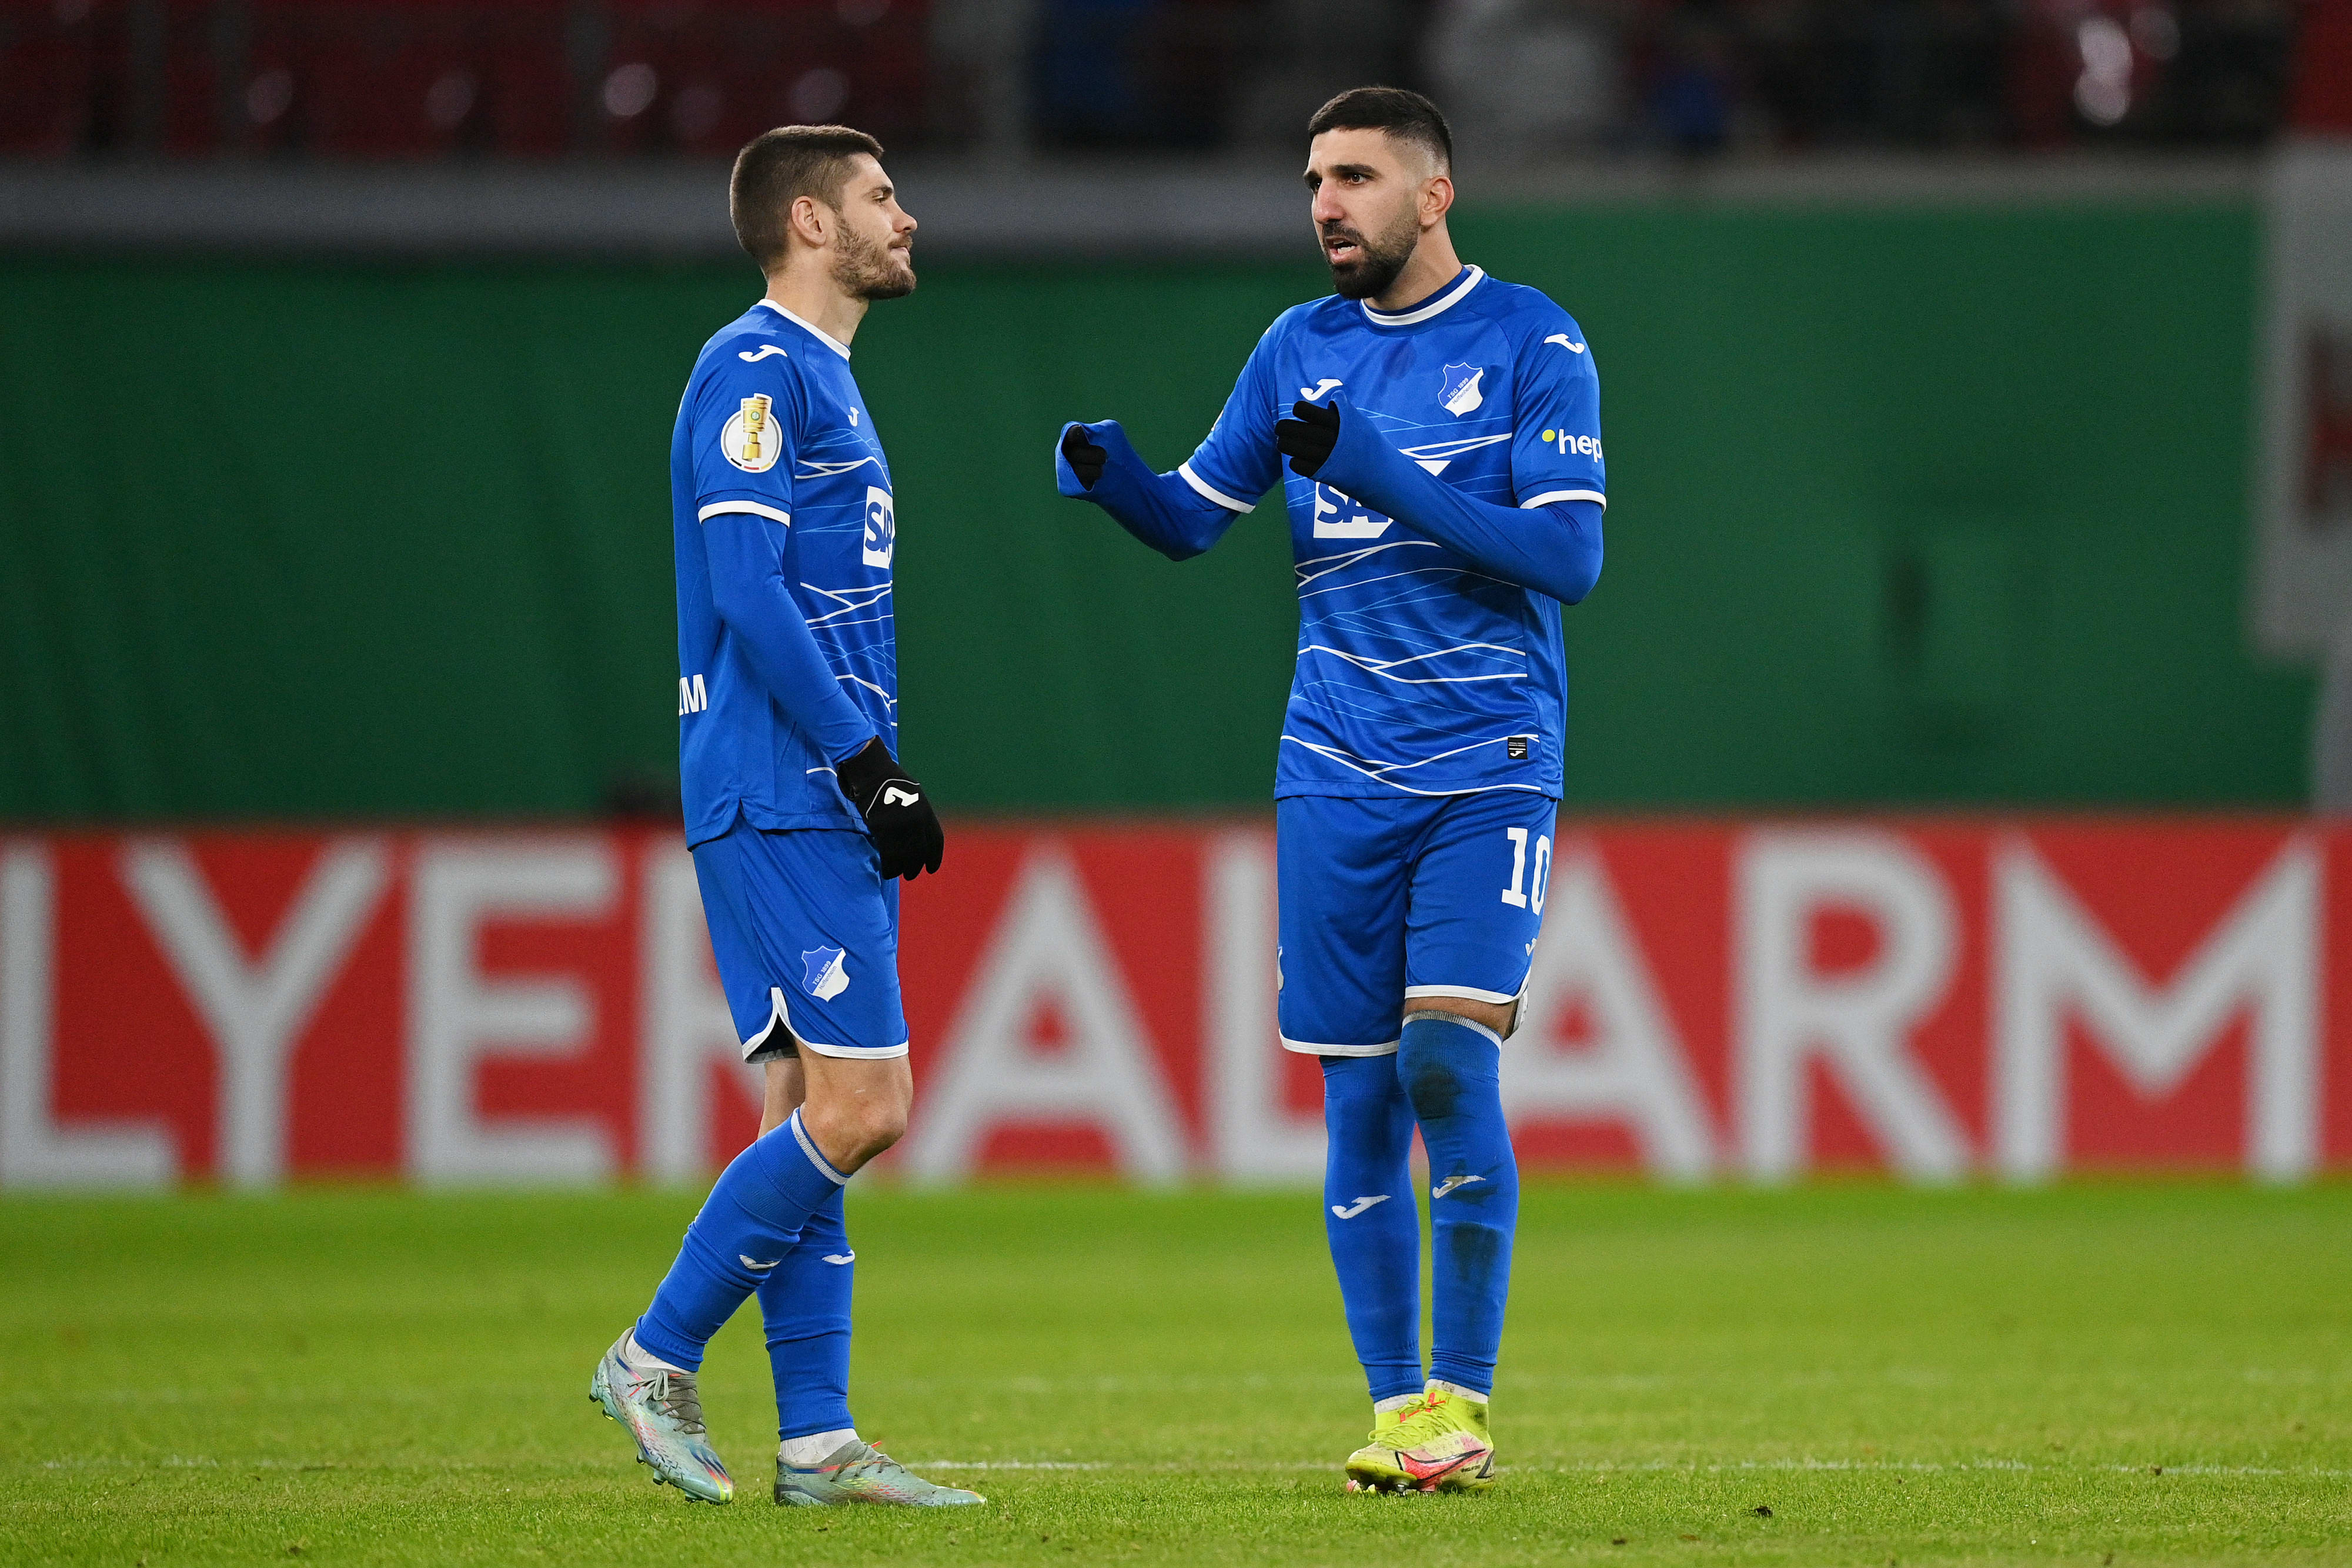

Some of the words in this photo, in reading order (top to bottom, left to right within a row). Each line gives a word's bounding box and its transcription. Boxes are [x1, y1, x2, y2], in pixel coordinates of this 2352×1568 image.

[1447, 387, 1458, 399] TSG
[1458, 377, 1469, 389] 1899
[1558, 429, 1603, 463] hep
[1317, 482, 1389, 524] SA
[1501, 827, 1550, 916] 10
[812, 973, 823, 986] TSG
[821, 960, 832, 974] 1899
